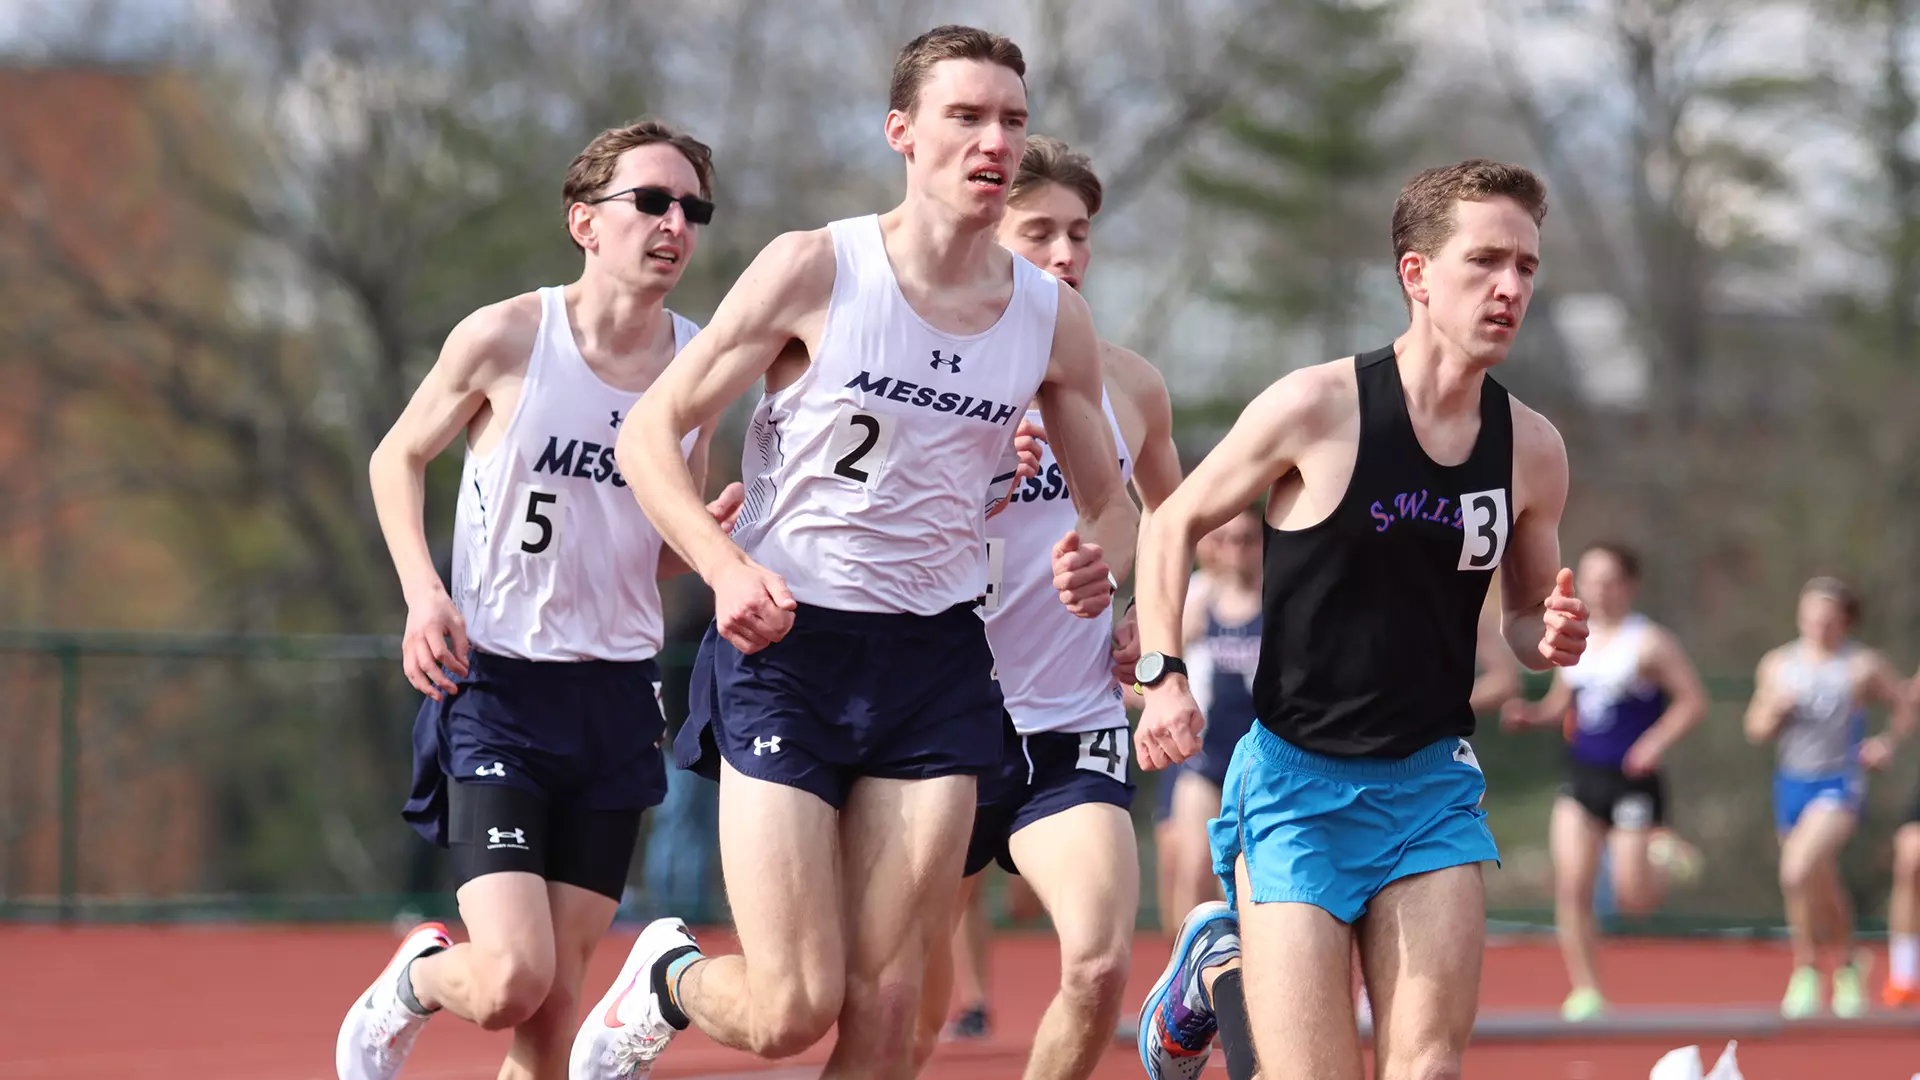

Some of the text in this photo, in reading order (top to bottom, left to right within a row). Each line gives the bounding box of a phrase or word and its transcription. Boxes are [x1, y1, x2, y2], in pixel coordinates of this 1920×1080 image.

[844, 371, 1017, 426] MESSIAH
[833, 414, 880, 483] 2
[521, 491, 557, 554] 5
[1469, 495, 1498, 567] 3
[1089, 730, 1121, 774] 4
